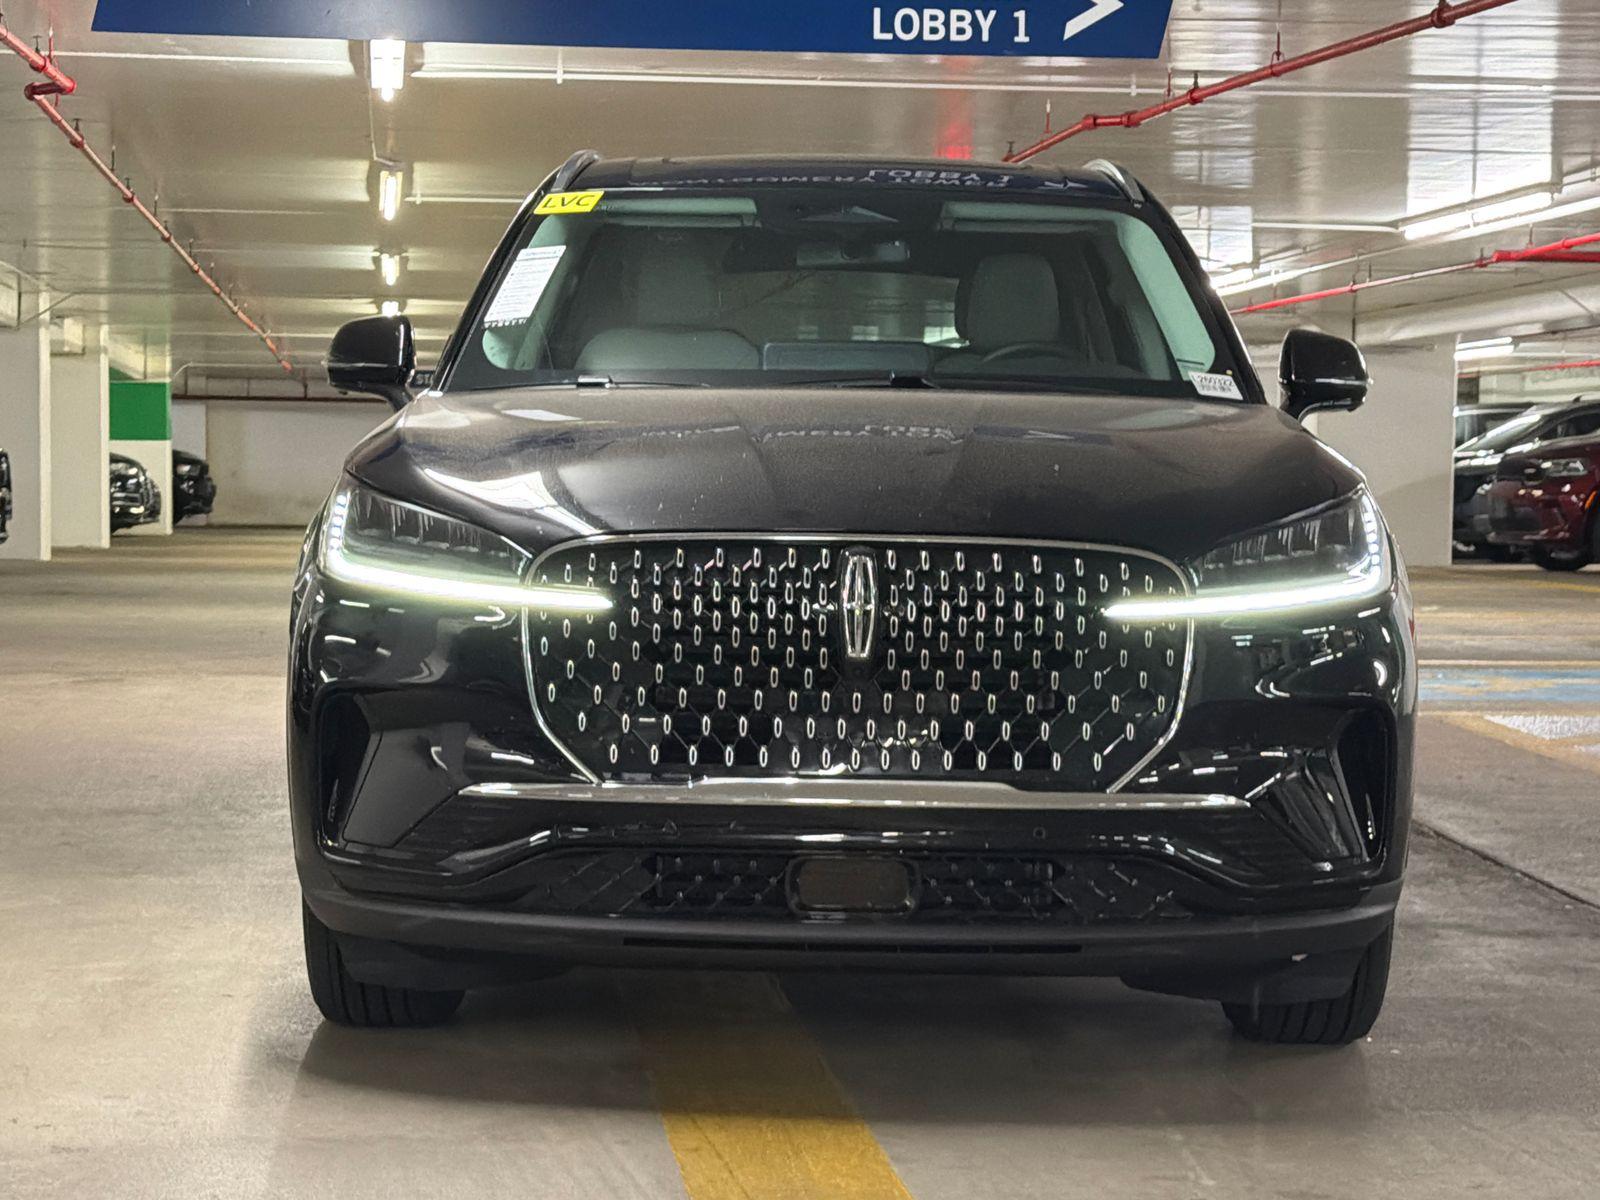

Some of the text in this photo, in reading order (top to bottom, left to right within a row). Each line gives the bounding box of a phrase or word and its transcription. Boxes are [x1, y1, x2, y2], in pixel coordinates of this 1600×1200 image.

[873, 7, 1030, 43] LOBBY 1
[541, 194, 596, 209] LVC
